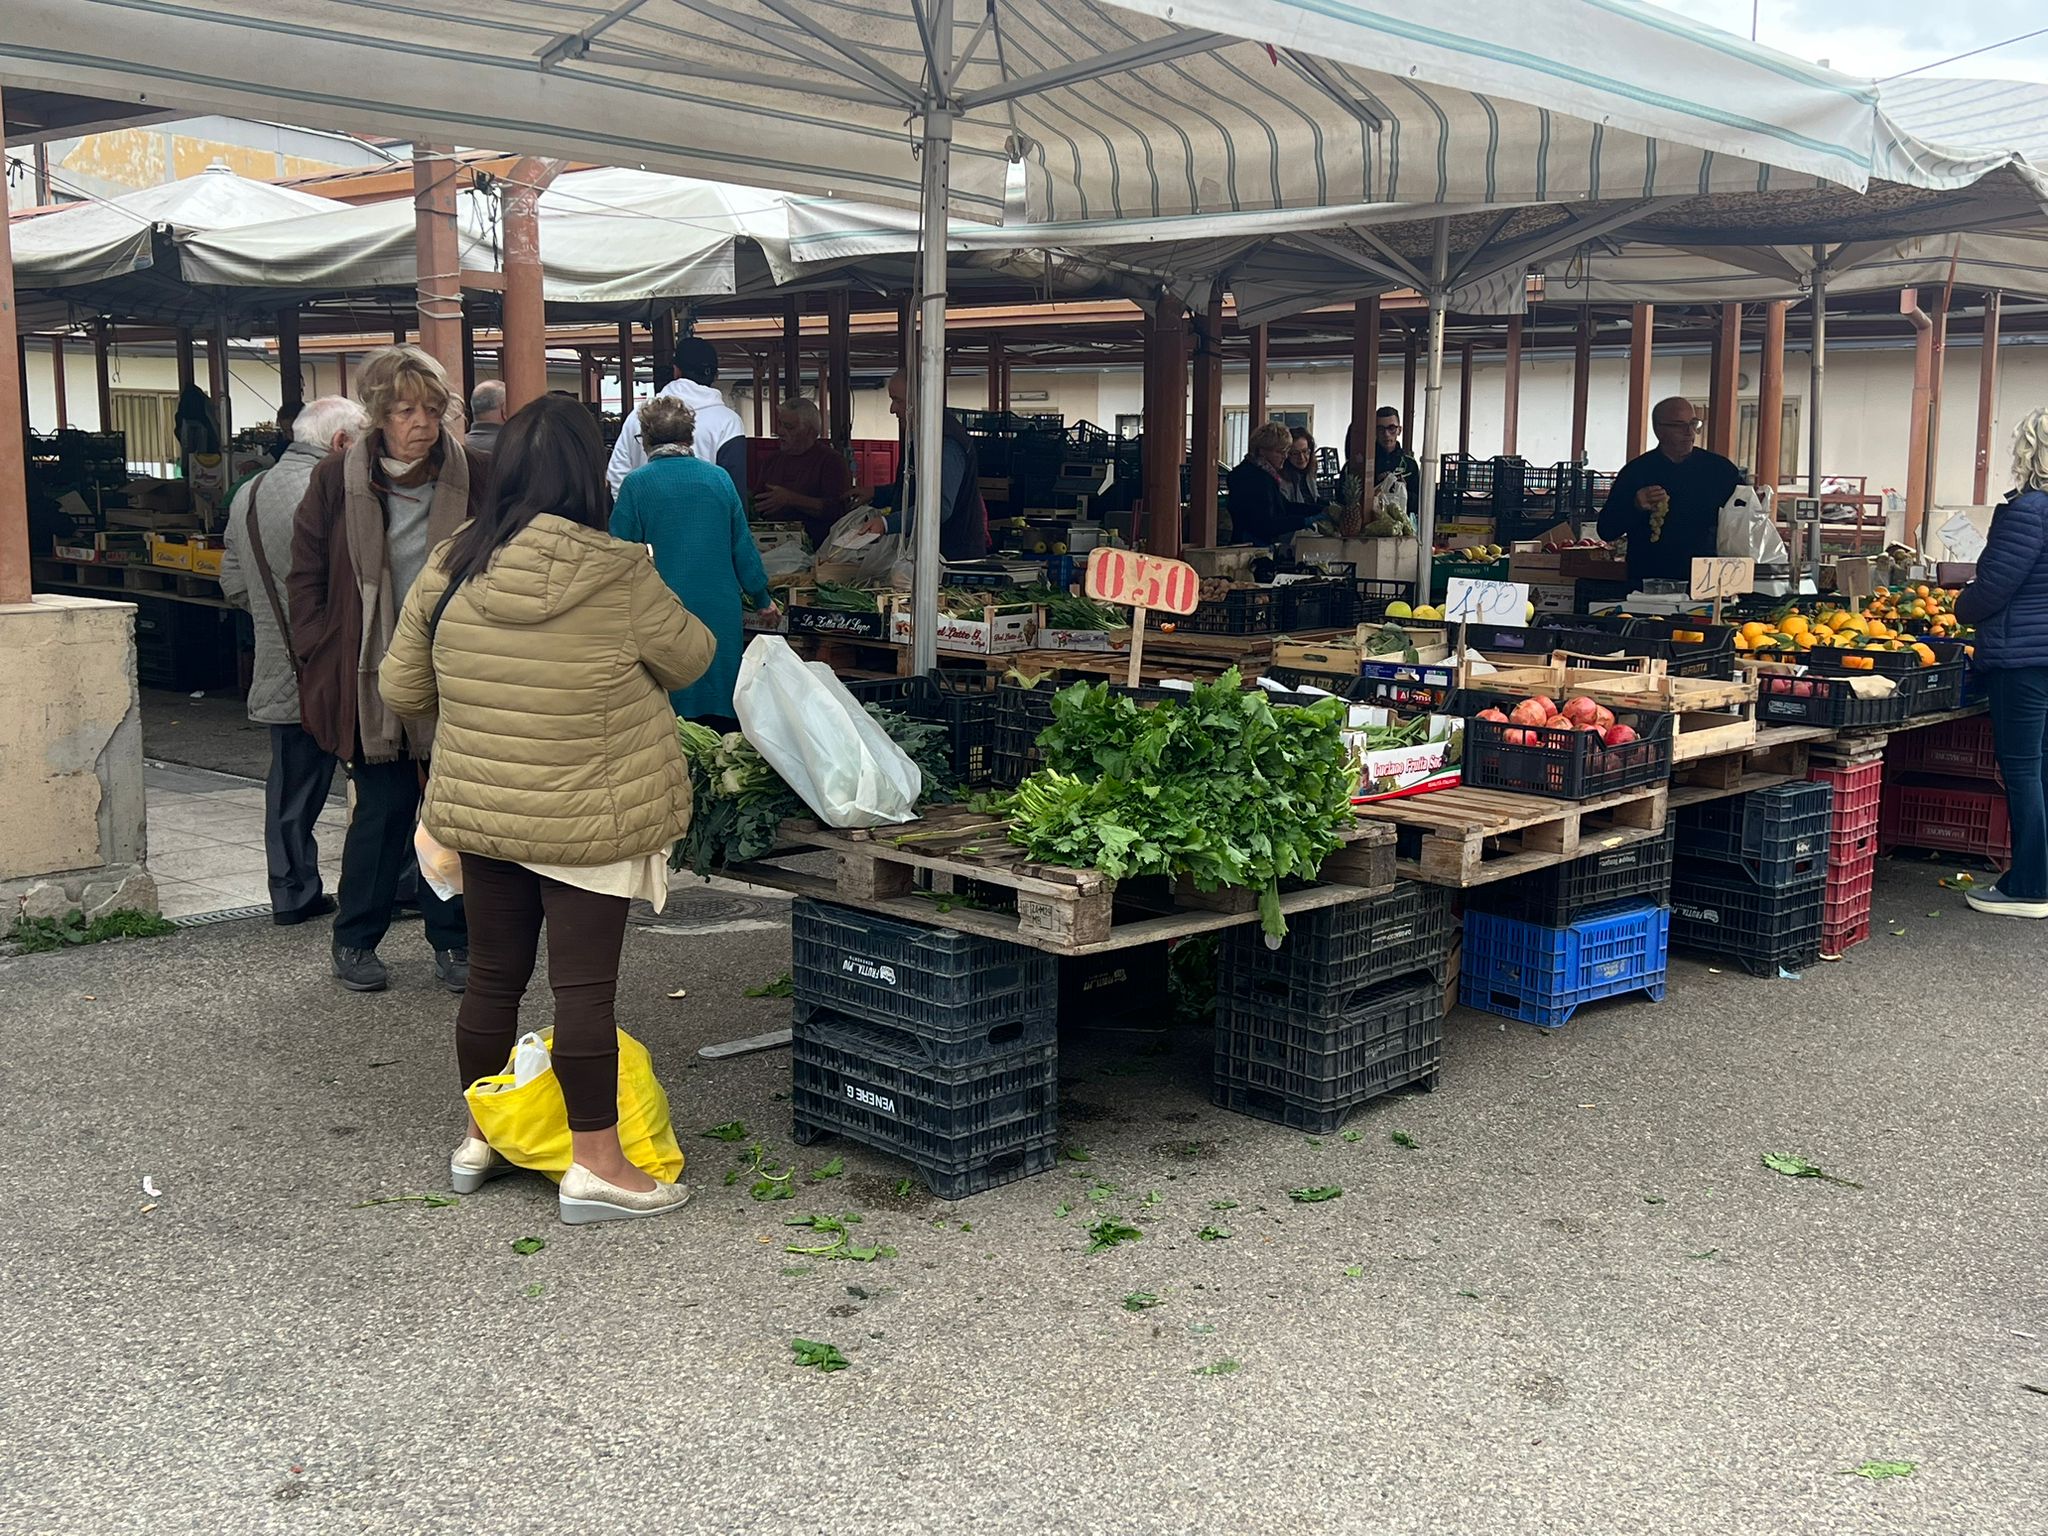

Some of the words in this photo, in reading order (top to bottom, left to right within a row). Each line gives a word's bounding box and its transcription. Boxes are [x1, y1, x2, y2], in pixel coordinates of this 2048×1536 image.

[800, 614, 814, 627] La
[849, 618, 872, 634] Lupo
[1374, 762, 1404, 777] Luciano
[1405, 757, 1428, 773] Frutta
[855, 1088, 895, 1113] VENERE
